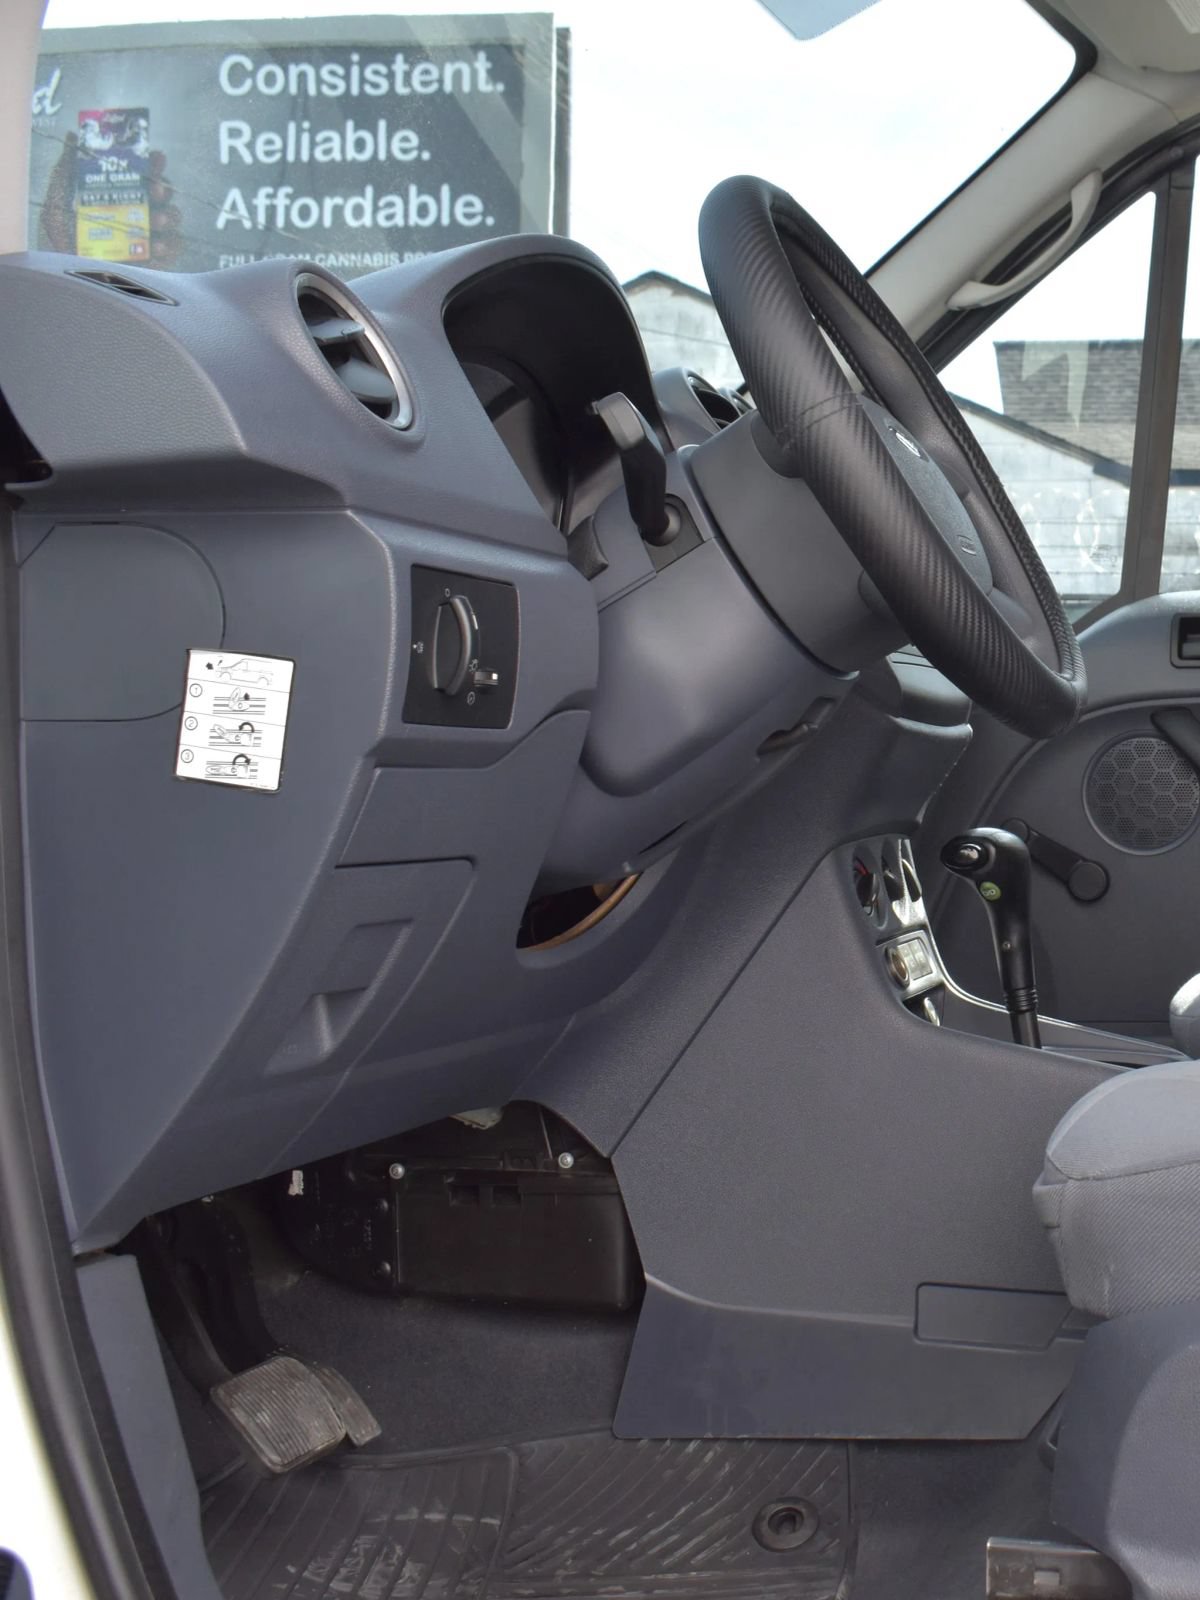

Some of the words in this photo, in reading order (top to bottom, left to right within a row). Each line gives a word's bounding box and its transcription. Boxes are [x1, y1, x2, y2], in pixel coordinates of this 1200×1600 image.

[219, 51, 505, 97] Consistent.
[219, 119, 431, 165] Reliable.
[216, 183, 495, 230] Affordable.
[315, 252, 399, 267] CANNABIS
